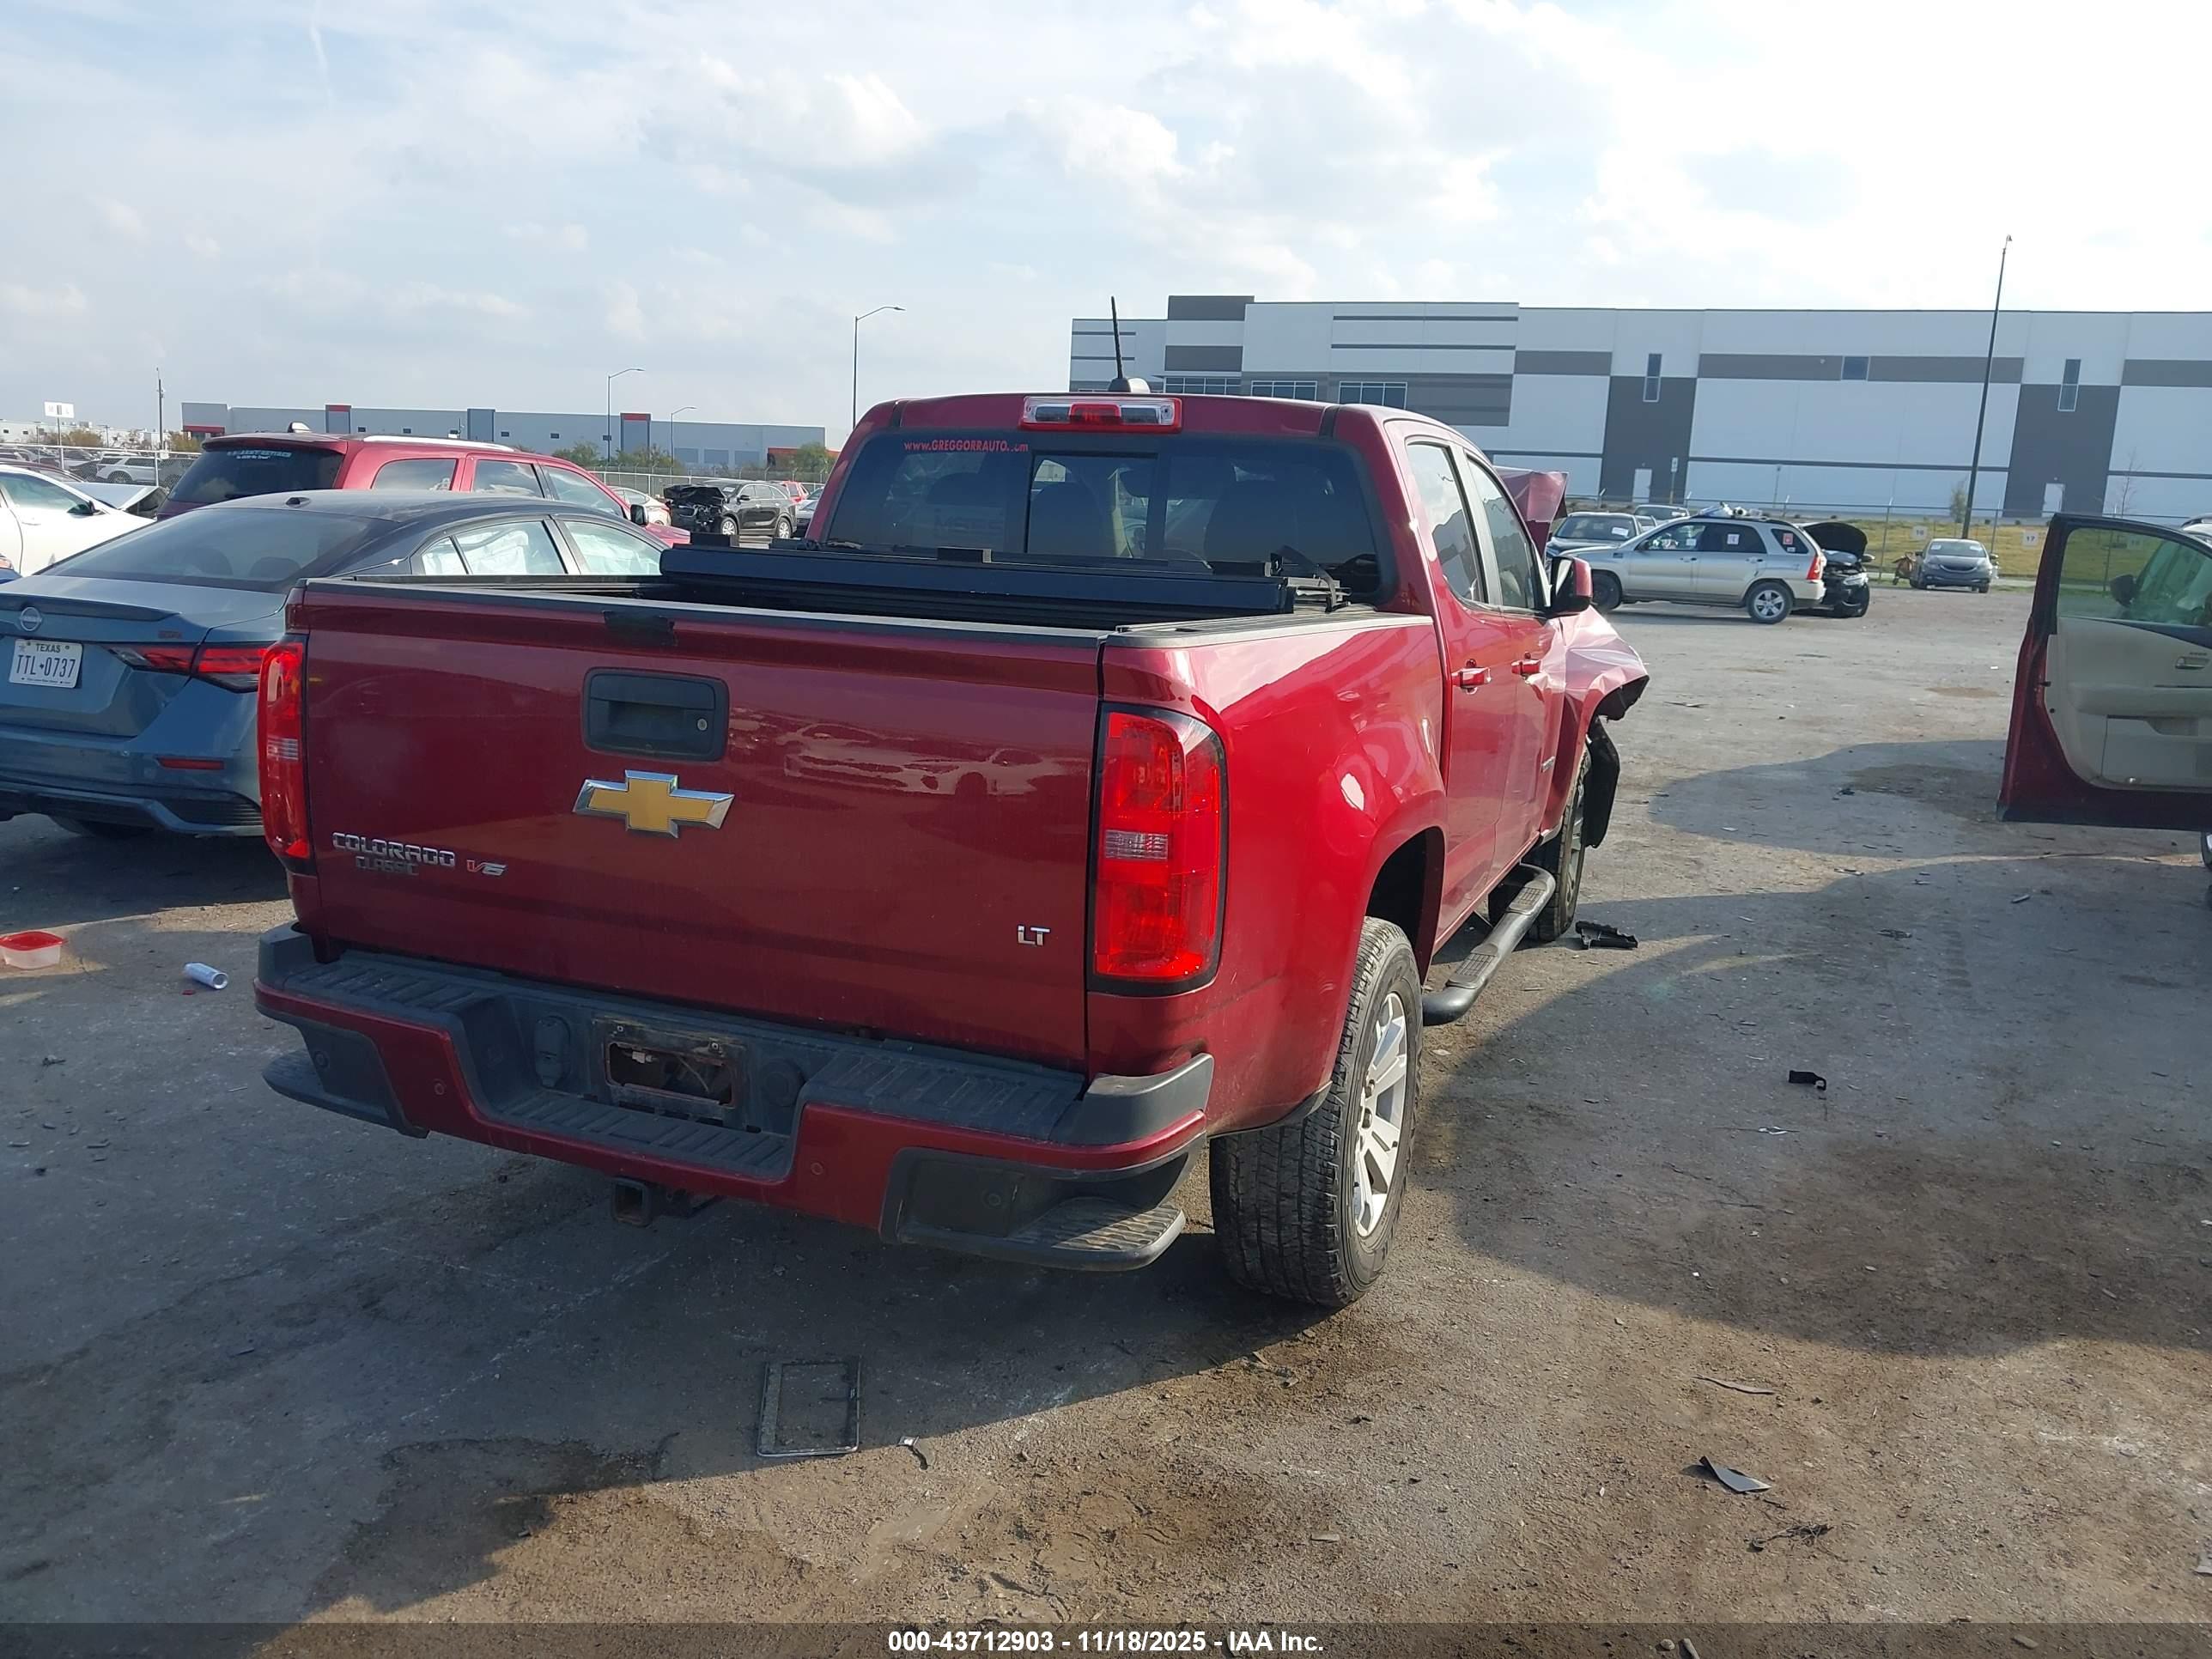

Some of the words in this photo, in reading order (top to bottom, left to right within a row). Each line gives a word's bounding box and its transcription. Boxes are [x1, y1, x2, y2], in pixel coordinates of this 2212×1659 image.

[903, 440, 1029, 453] www.GREGGORRAUTO.om
[35, 643, 61, 653] TEXAS
[332, 831, 455, 867] COLORADO
[467, 860, 507, 876] V6
[356, 856, 420, 876] CLASSIC
[1018, 926, 1050, 945] LT
